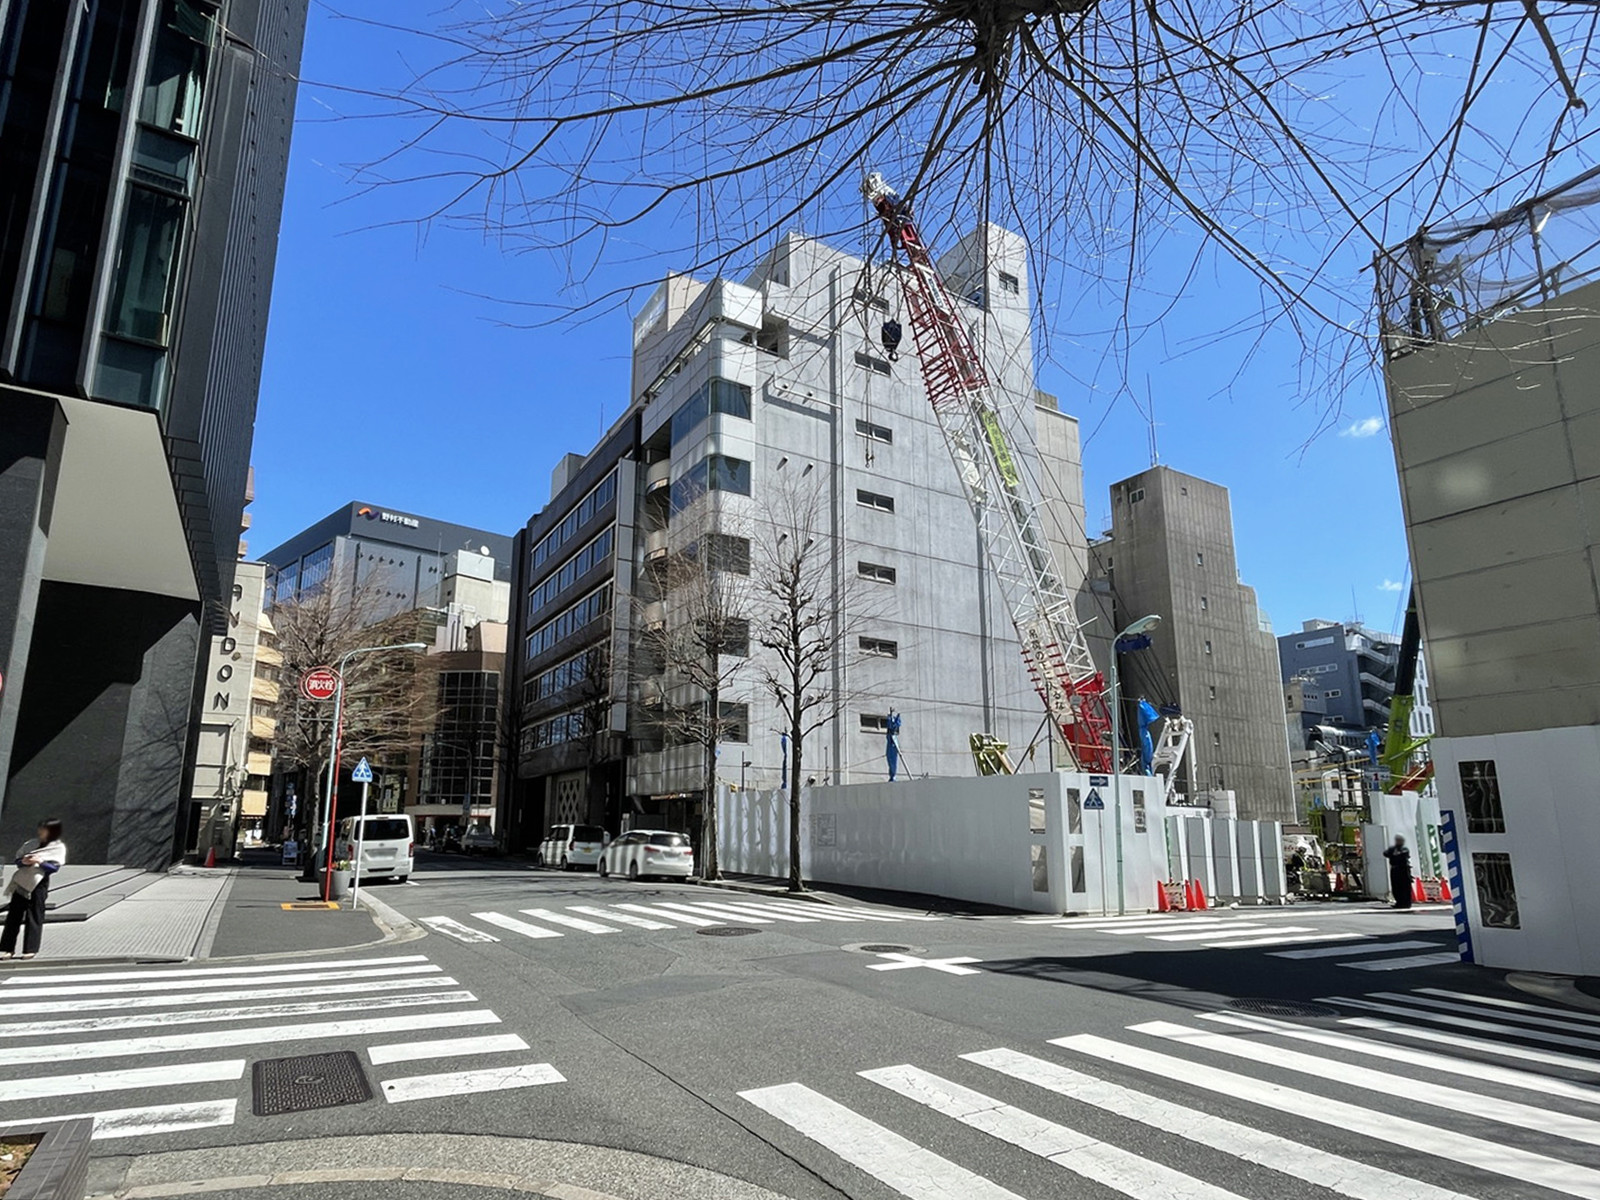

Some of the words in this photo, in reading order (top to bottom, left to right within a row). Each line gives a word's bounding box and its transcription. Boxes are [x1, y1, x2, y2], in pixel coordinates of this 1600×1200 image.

[381, 512, 419, 528] 野村不動産
[308, 679, 334, 691] 消火栓
